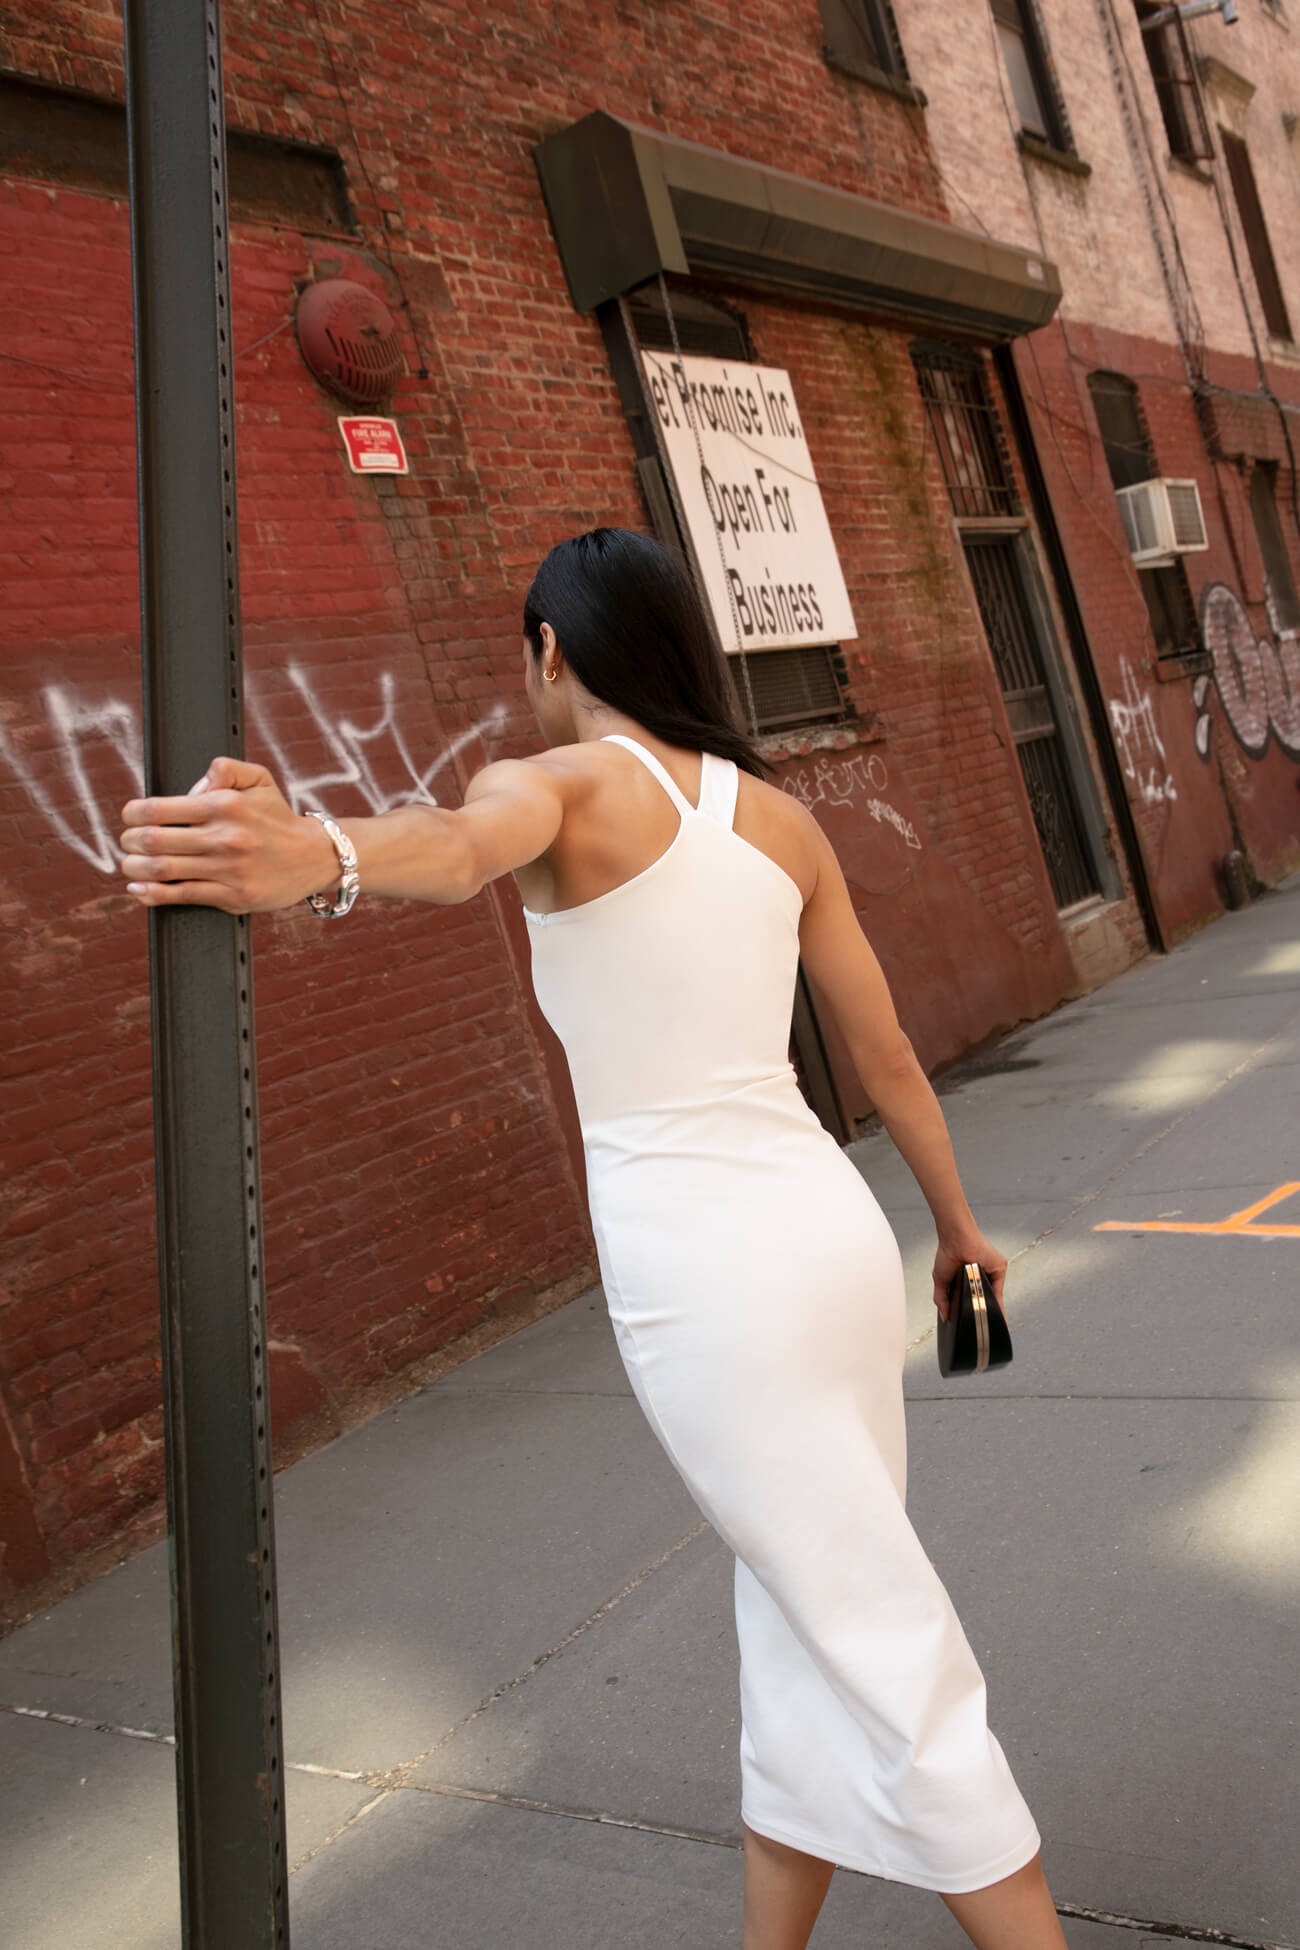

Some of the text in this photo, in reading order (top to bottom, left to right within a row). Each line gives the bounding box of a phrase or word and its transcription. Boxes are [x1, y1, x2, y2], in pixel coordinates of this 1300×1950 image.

[670, 360, 763, 436] Promise
[756, 372, 802, 439] Inc.
[700, 464, 798, 551] Open For
[726, 567, 824, 636] Business
